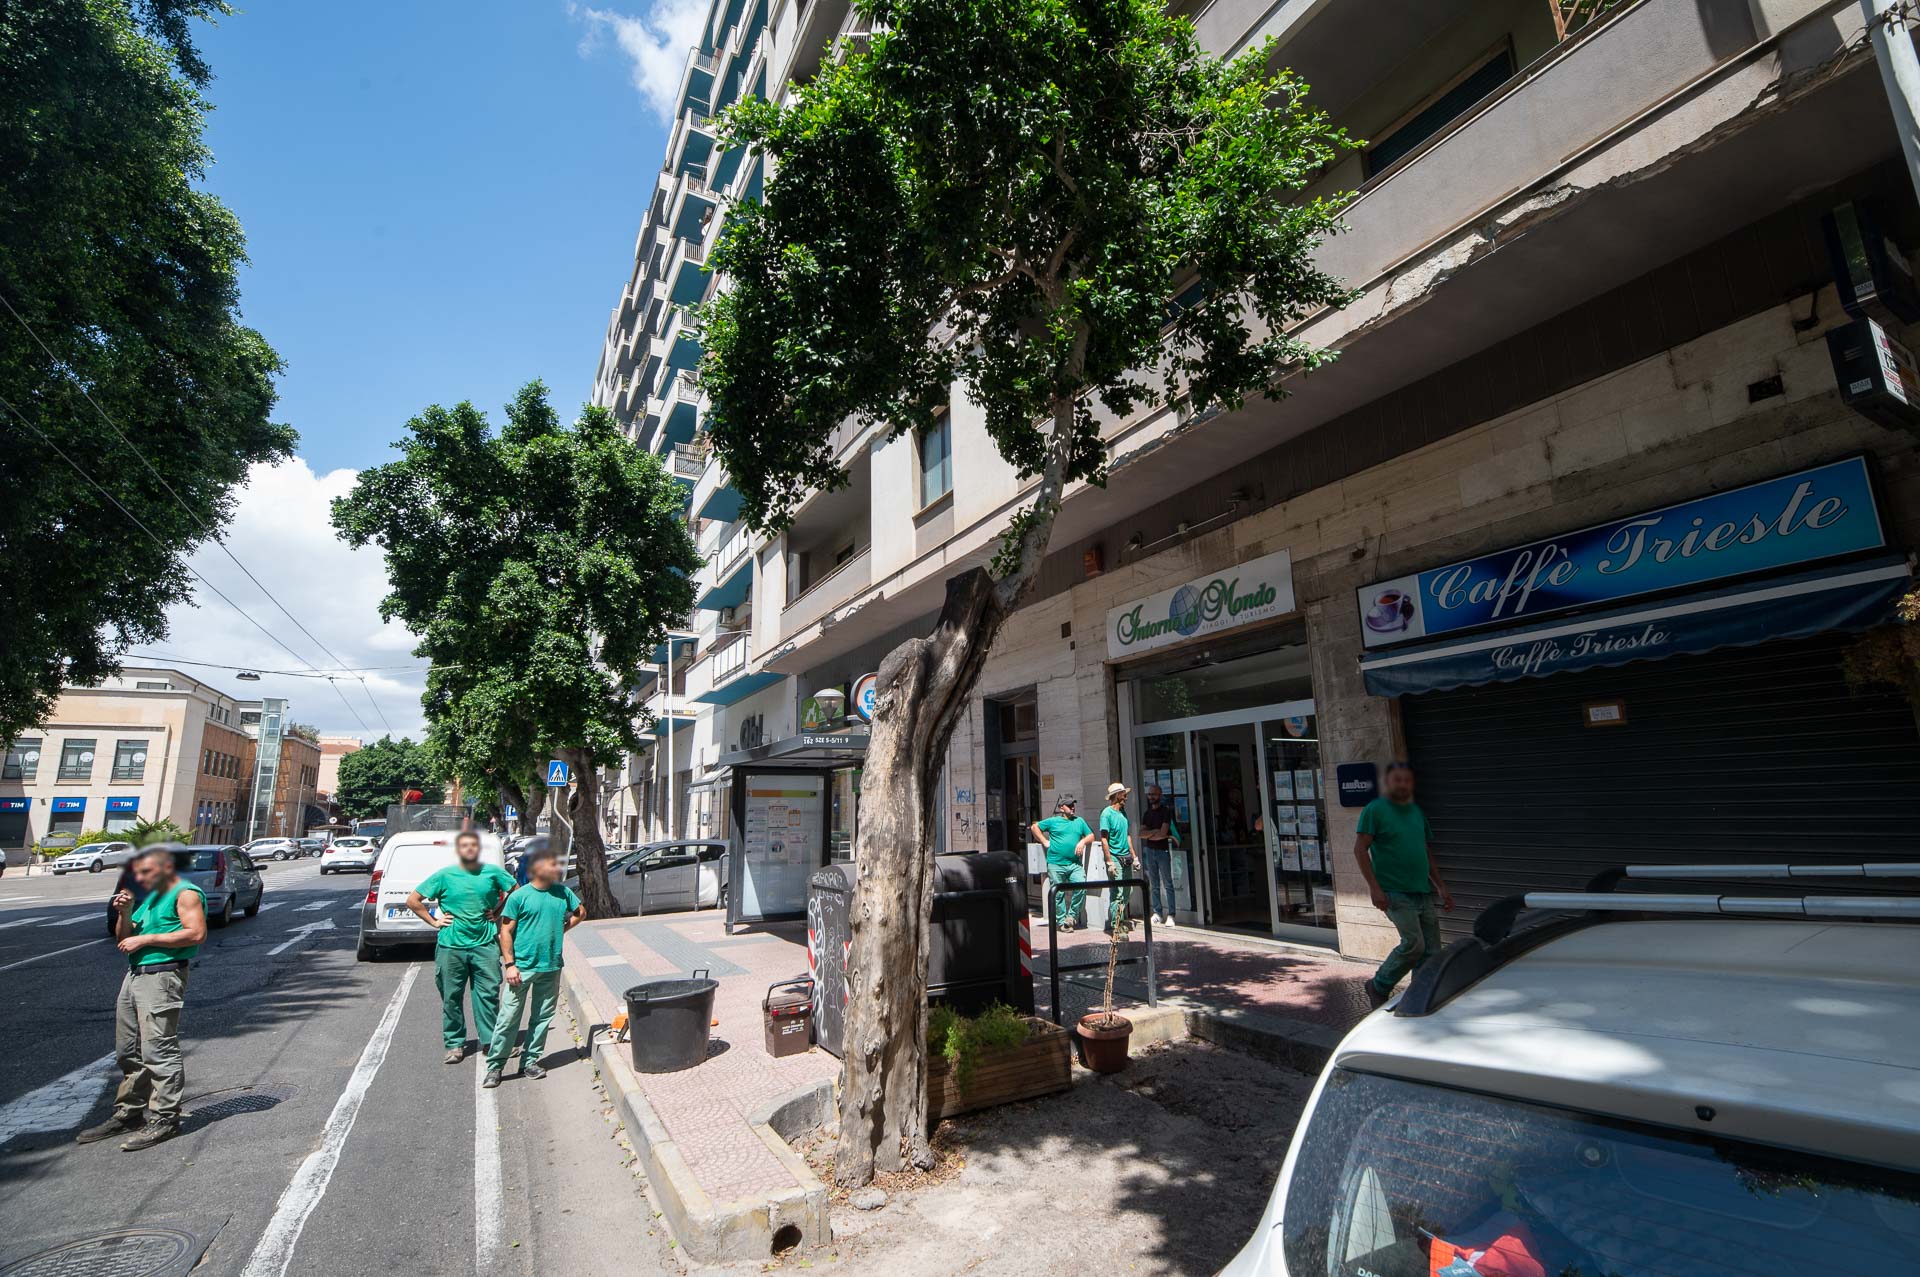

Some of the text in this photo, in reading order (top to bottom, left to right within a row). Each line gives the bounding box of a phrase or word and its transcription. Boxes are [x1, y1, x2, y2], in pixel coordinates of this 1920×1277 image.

[1430, 479, 1848, 618] Caffè Trieste
[1117, 577, 1277, 645] Intorno al Mondo
[1491, 624, 1671, 674] Caffè Trieste
